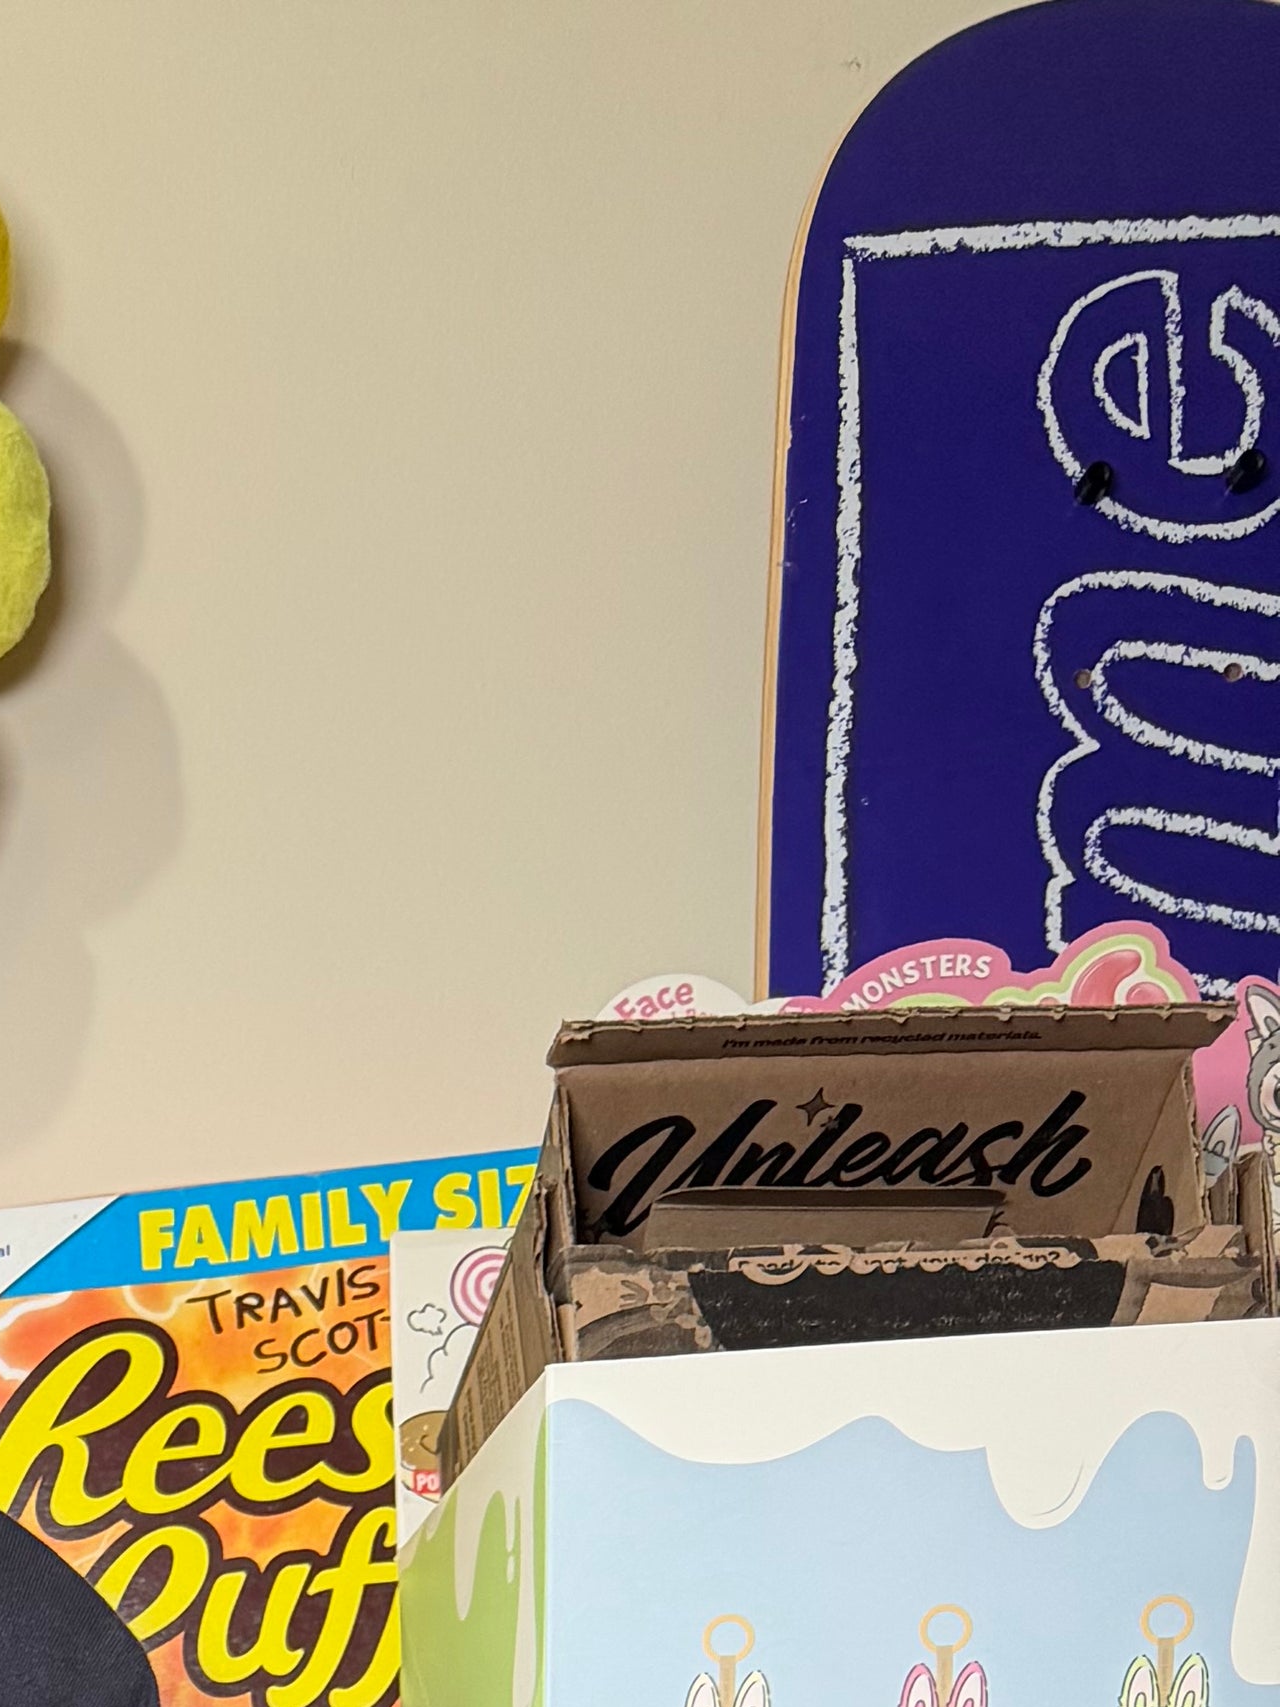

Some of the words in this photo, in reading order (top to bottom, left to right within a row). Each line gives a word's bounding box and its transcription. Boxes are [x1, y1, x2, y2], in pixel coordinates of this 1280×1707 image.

[841, 953, 993, 1013] MONSTERS
[809, 1035, 858, 1046] from
[588, 1090, 1093, 1243] Unleash
[140, 1180, 409, 1272] FAMILY
[433, 1164, 538, 1230] SIZ
[186, 1264, 381, 1335] TRAVIS
[254, 1308, 391, 1375] SCOT
[415, 1471, 440, 1494] PO
